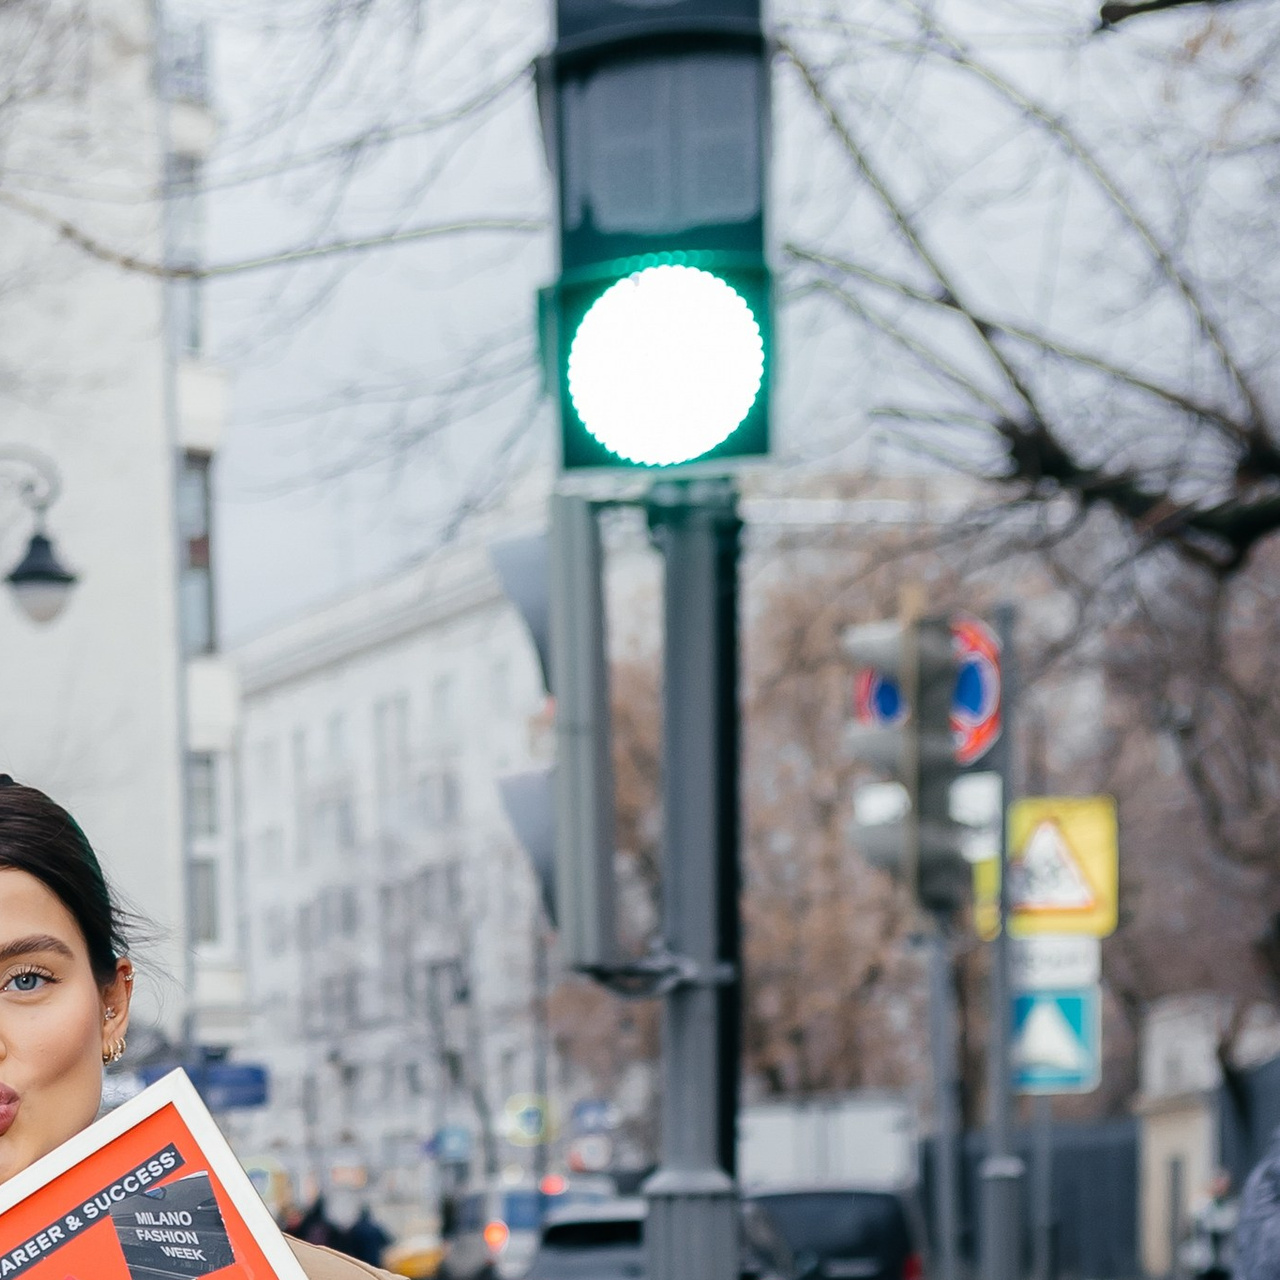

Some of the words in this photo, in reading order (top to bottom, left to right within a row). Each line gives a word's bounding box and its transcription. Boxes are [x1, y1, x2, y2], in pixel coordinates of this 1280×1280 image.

[65, 1215, 83, 1231] &
[83, 1151, 175, 1219] SUCCESS
[135, 1211, 192, 1227] MILANO
[136, 1229, 200, 1245] FASHION
[161, 1246, 207, 1262] WEEK
